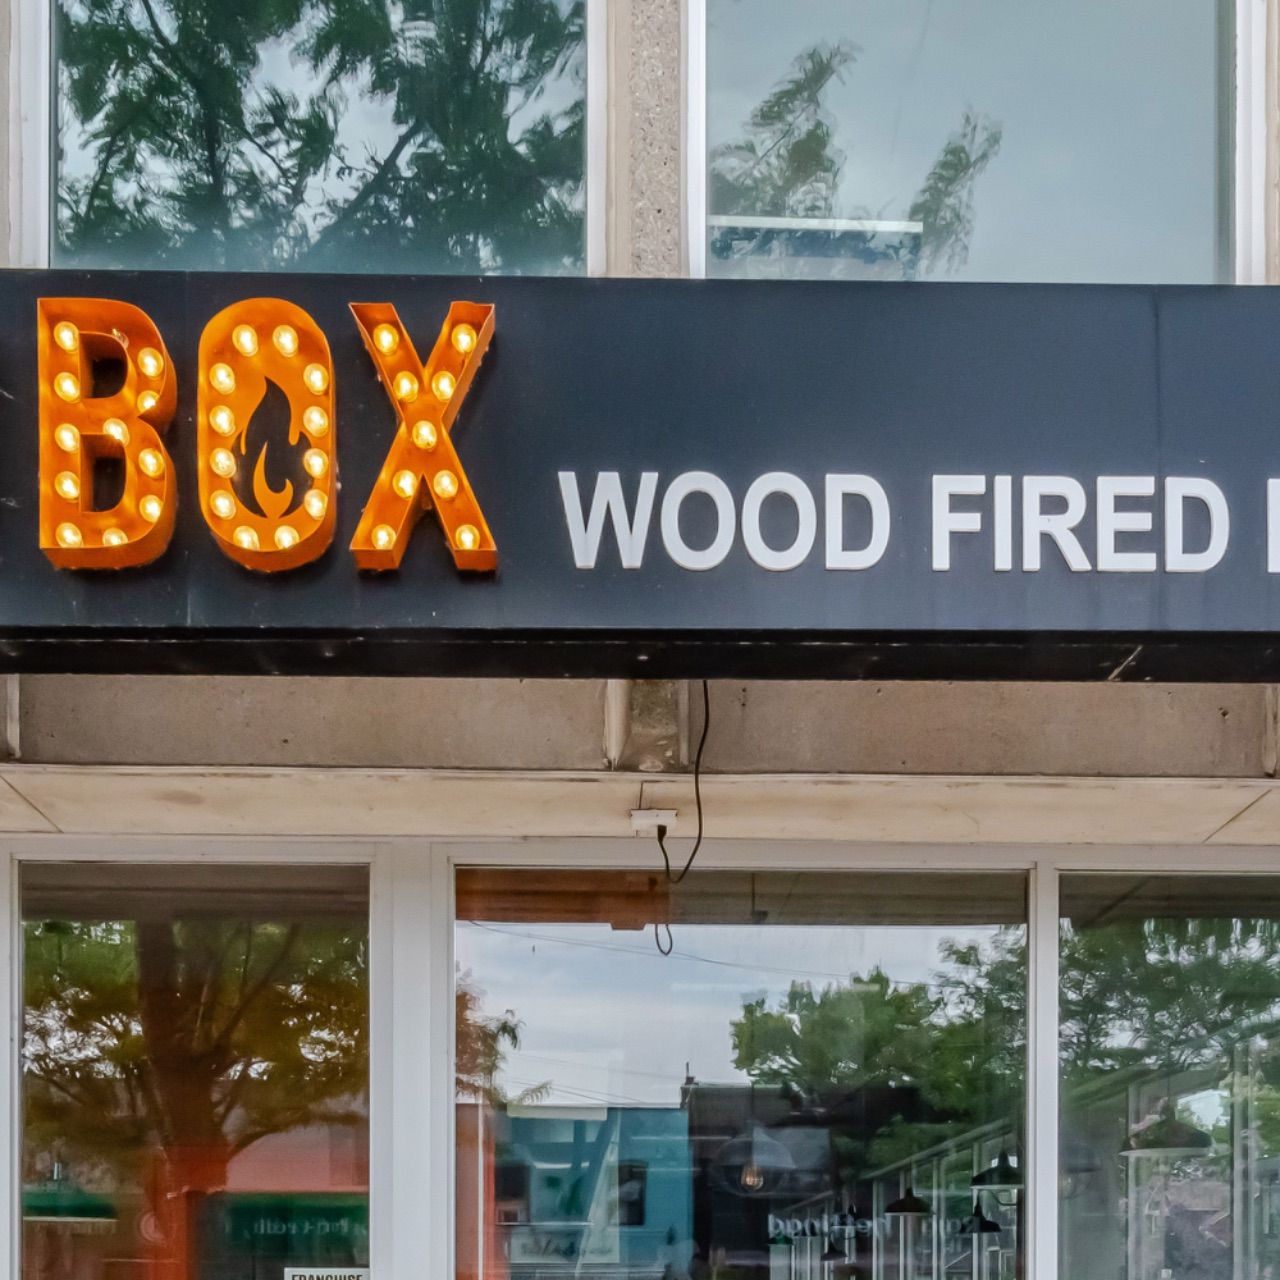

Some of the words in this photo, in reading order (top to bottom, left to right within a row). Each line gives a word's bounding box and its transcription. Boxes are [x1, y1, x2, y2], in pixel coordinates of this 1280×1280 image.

[36, 296, 498, 573] BOX
[557, 470, 891, 571] WOOD
[931, 474, 1230, 573] FIRED
